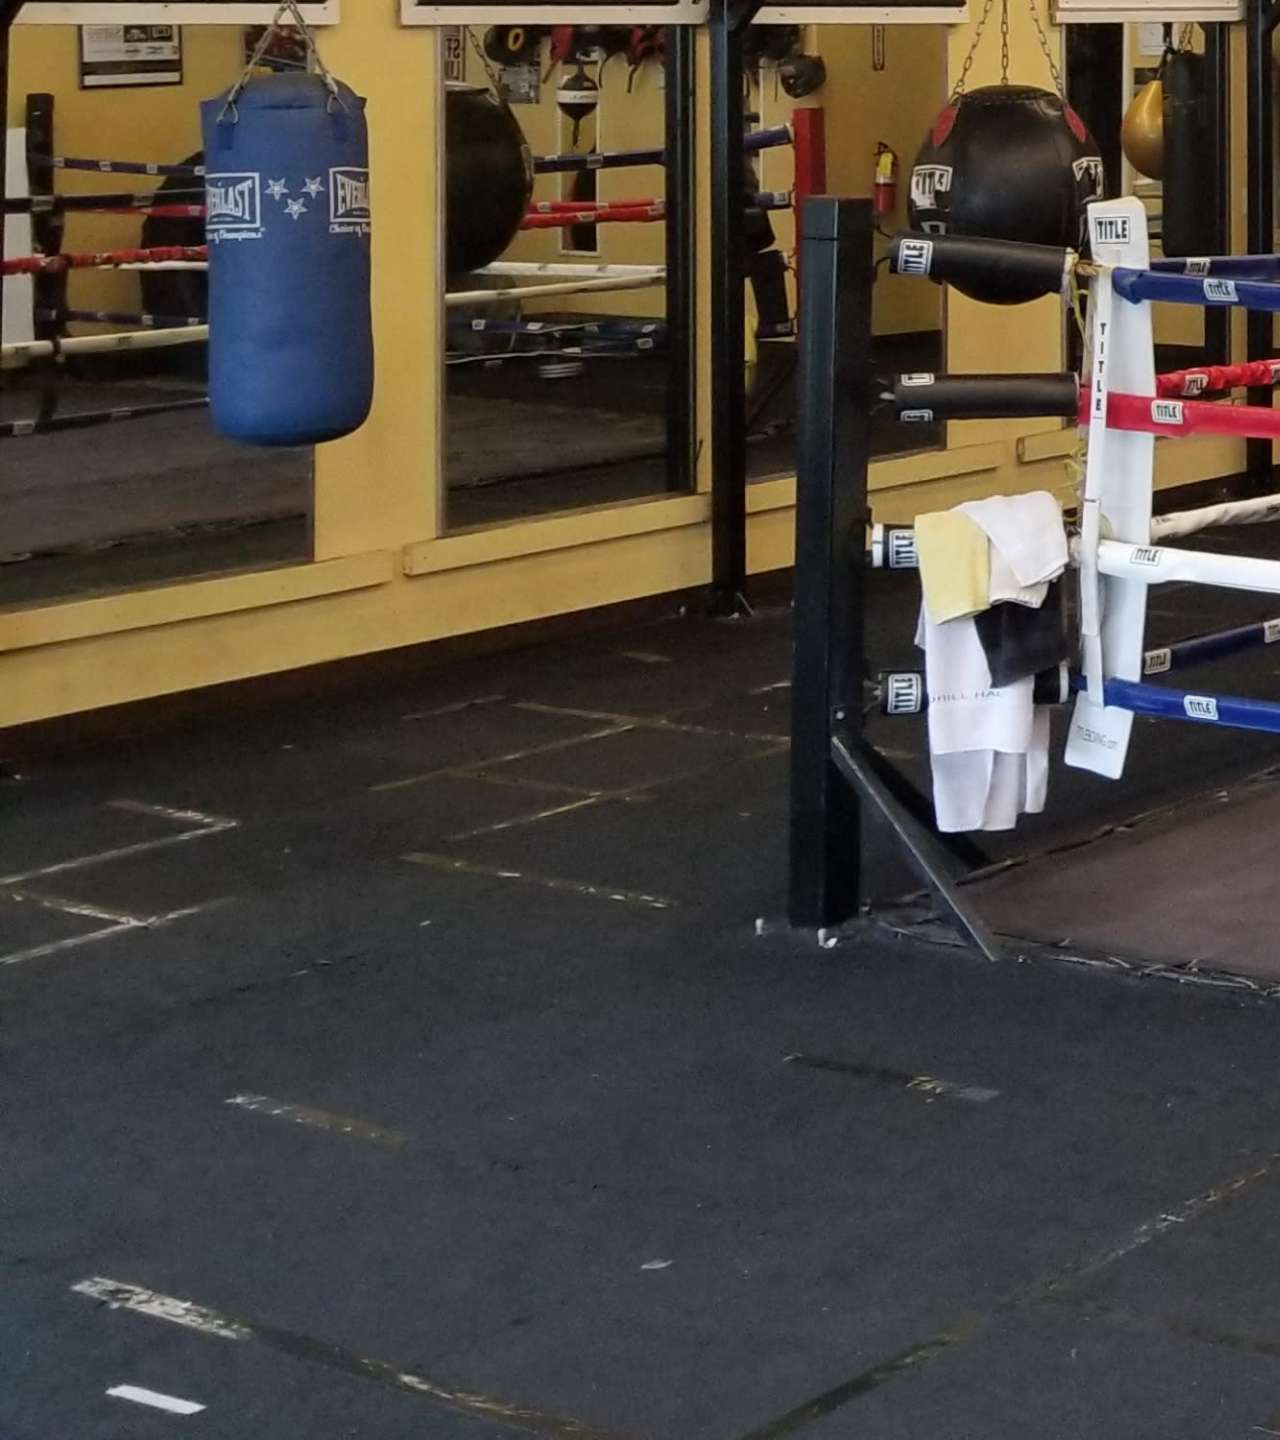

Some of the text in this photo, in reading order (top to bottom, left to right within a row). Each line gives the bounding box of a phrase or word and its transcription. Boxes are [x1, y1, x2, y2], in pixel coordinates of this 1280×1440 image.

[1097, 221, 1128, 239] TITLE
[1208, 281, 1232, 297] TITLE
[1095, 322, 1107, 412] TITLE
[1156, 405, 1177, 419] TITLE
[1136, 549, 1159, 563] TITLE
[894, 678, 914, 710] TITLE
[1189, 700, 1212, 715] TITLE
